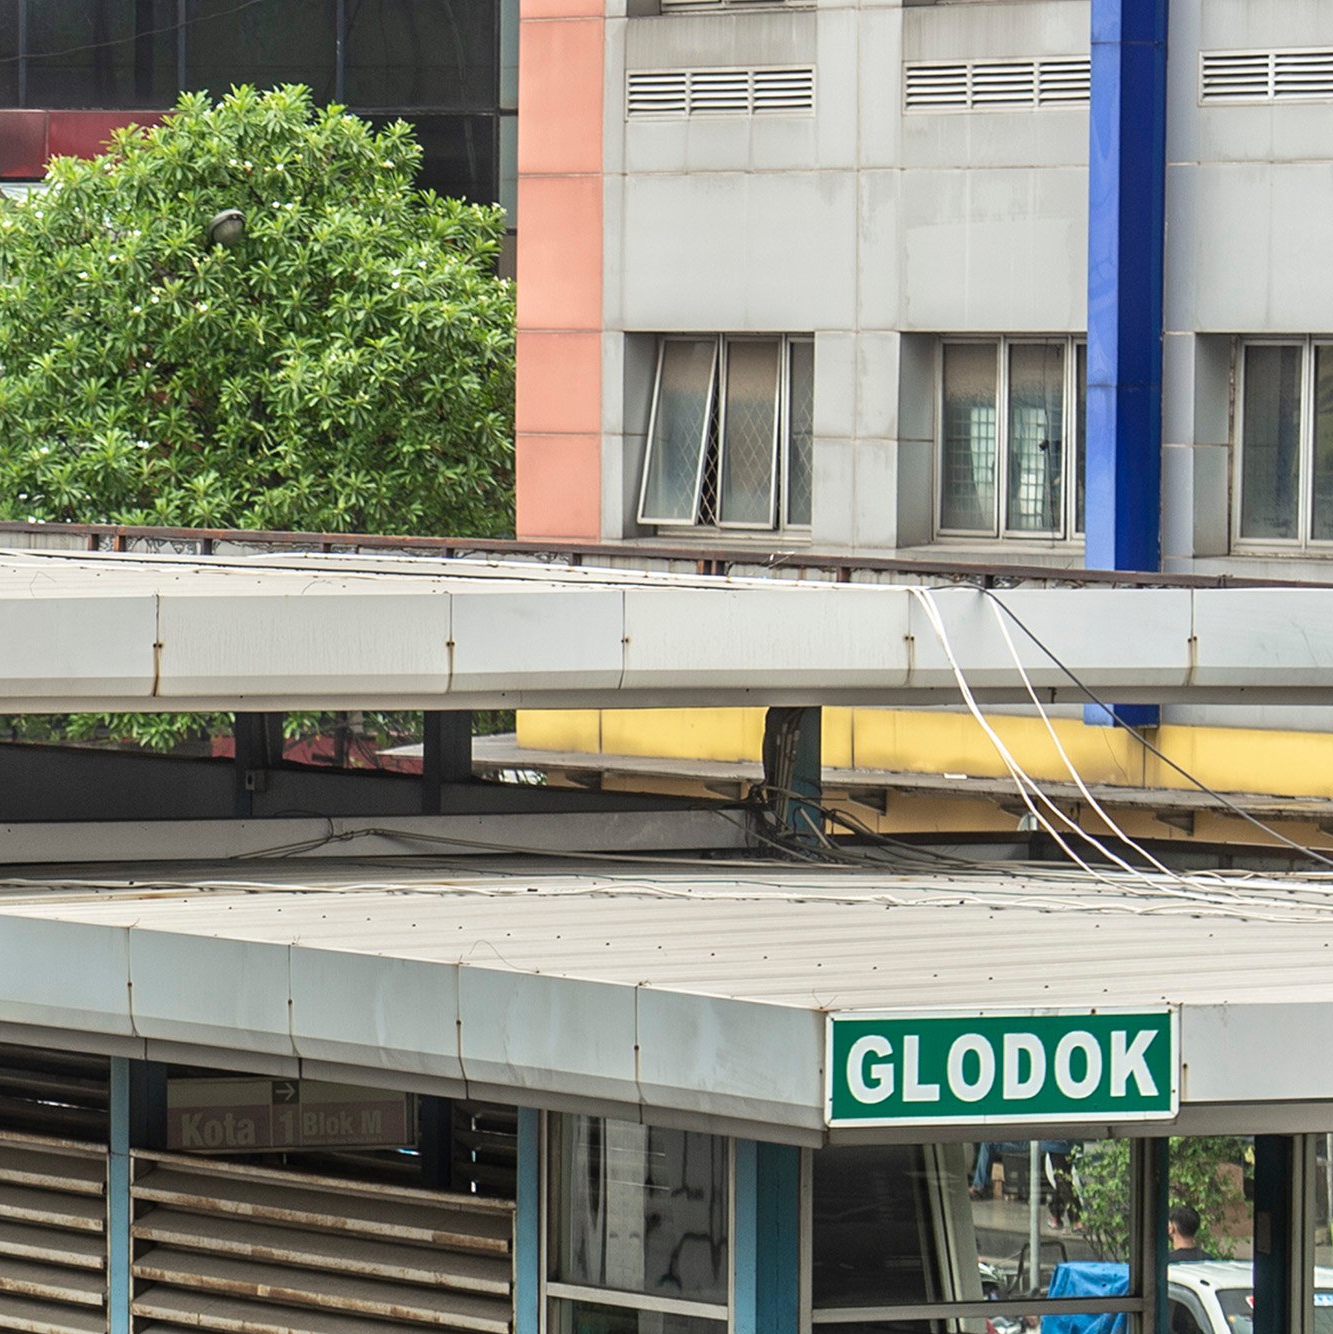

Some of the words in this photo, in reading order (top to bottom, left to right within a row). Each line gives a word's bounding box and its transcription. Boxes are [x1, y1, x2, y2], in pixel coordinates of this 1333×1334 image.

[846, 1029, 1160, 1105] GLODOK
[182, 1111, 257, 1147] Kota
[279, 1110, 294, 1145] 1
[303, 1111, 354, 1136] Blok
[361, 1110, 382, 1135] M
